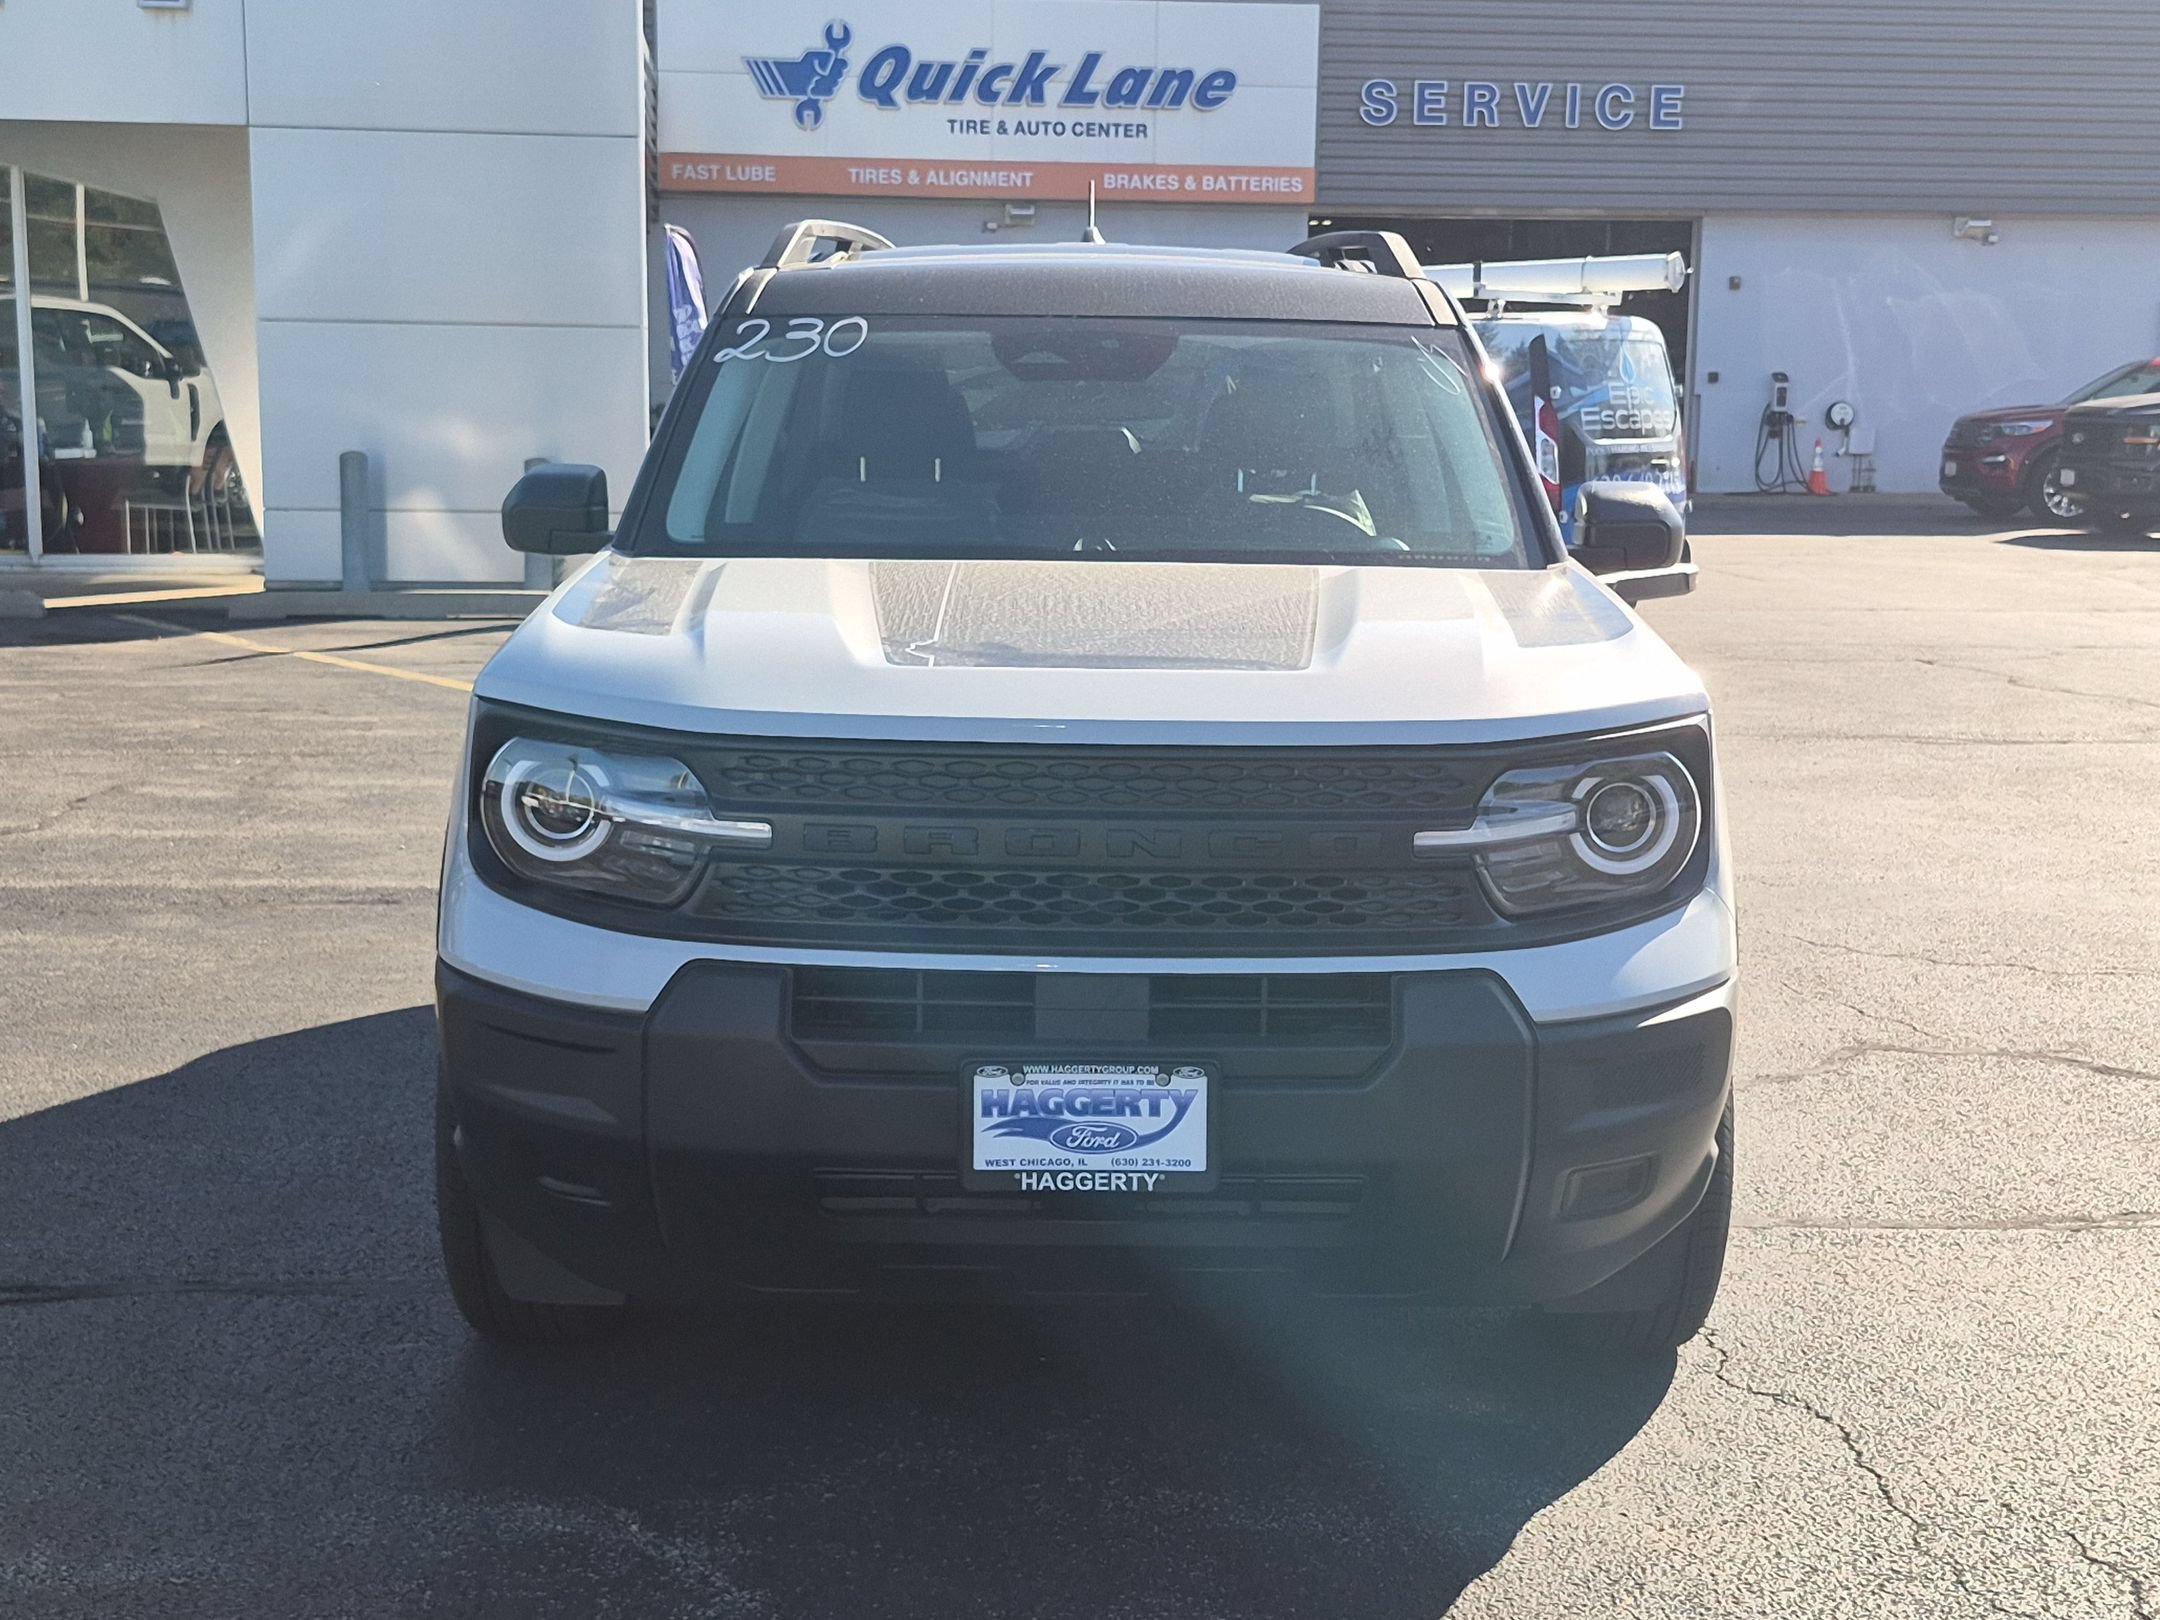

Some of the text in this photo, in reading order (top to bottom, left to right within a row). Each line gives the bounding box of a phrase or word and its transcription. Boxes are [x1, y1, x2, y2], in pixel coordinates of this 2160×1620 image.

[857, 43, 1239, 112] Quick Lane
[1359, 78, 1685, 131] SERVICE
[946, 119, 1149, 138] TIRE & AUTO CENTER
[671, 164, 777, 183] FAST LUBE
[848, 167, 1034, 188] TIRES & ALIGNMENT
[1103, 173, 1304, 192] BRAKES & BATTERIES
[712, 315, 869, 363] 230
[1580, 407, 1674, 435] Escapes
[802, 819, 1384, 860] BRONCO
[1022, 1065, 1160, 1075] WWW.HAGGERTYGROUP.COM
[981, 1088, 1198, 1118] HAGGERTY
[1066, 1125, 1121, 1149] Ford
[985, 1158, 1088, 1168] WEST CHICAGO, IL
[1111, 1158, 1192, 1168] (630) 231-3200
[1020, 1172, 1159, 1191] HAGGERTY
